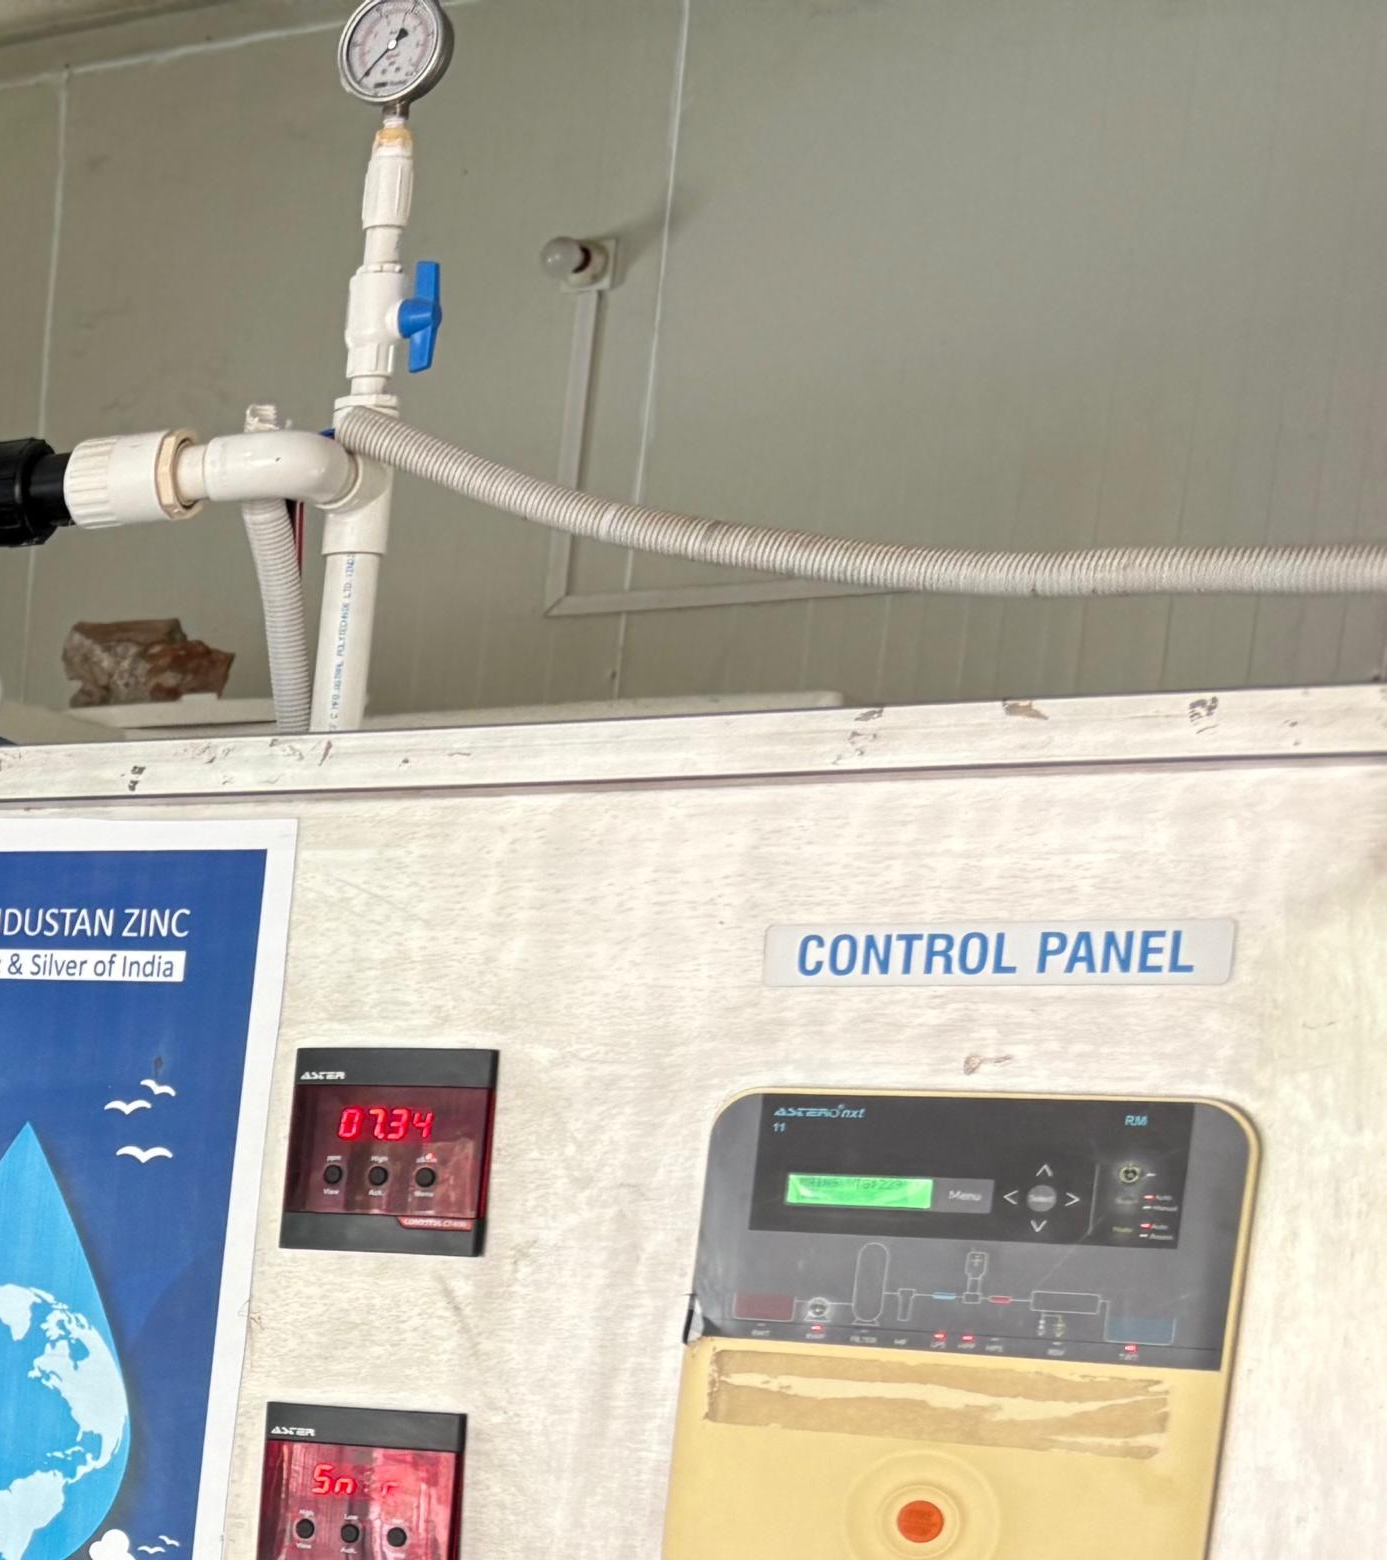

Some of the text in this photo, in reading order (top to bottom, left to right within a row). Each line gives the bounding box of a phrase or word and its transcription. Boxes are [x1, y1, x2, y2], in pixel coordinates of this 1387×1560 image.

[121, 908, 191, 938] ZINC
[7, 955, 25, 976] &
[30, 954, 89, 978] Silver
[93, 955, 117, 978] of
[121, 956, 174, 979] India
[797, 931, 1195, 977] CONTROL PANEL
[948, 1189, 982, 1201] Menu
[850, 1335, 877, 1344] FILTER
